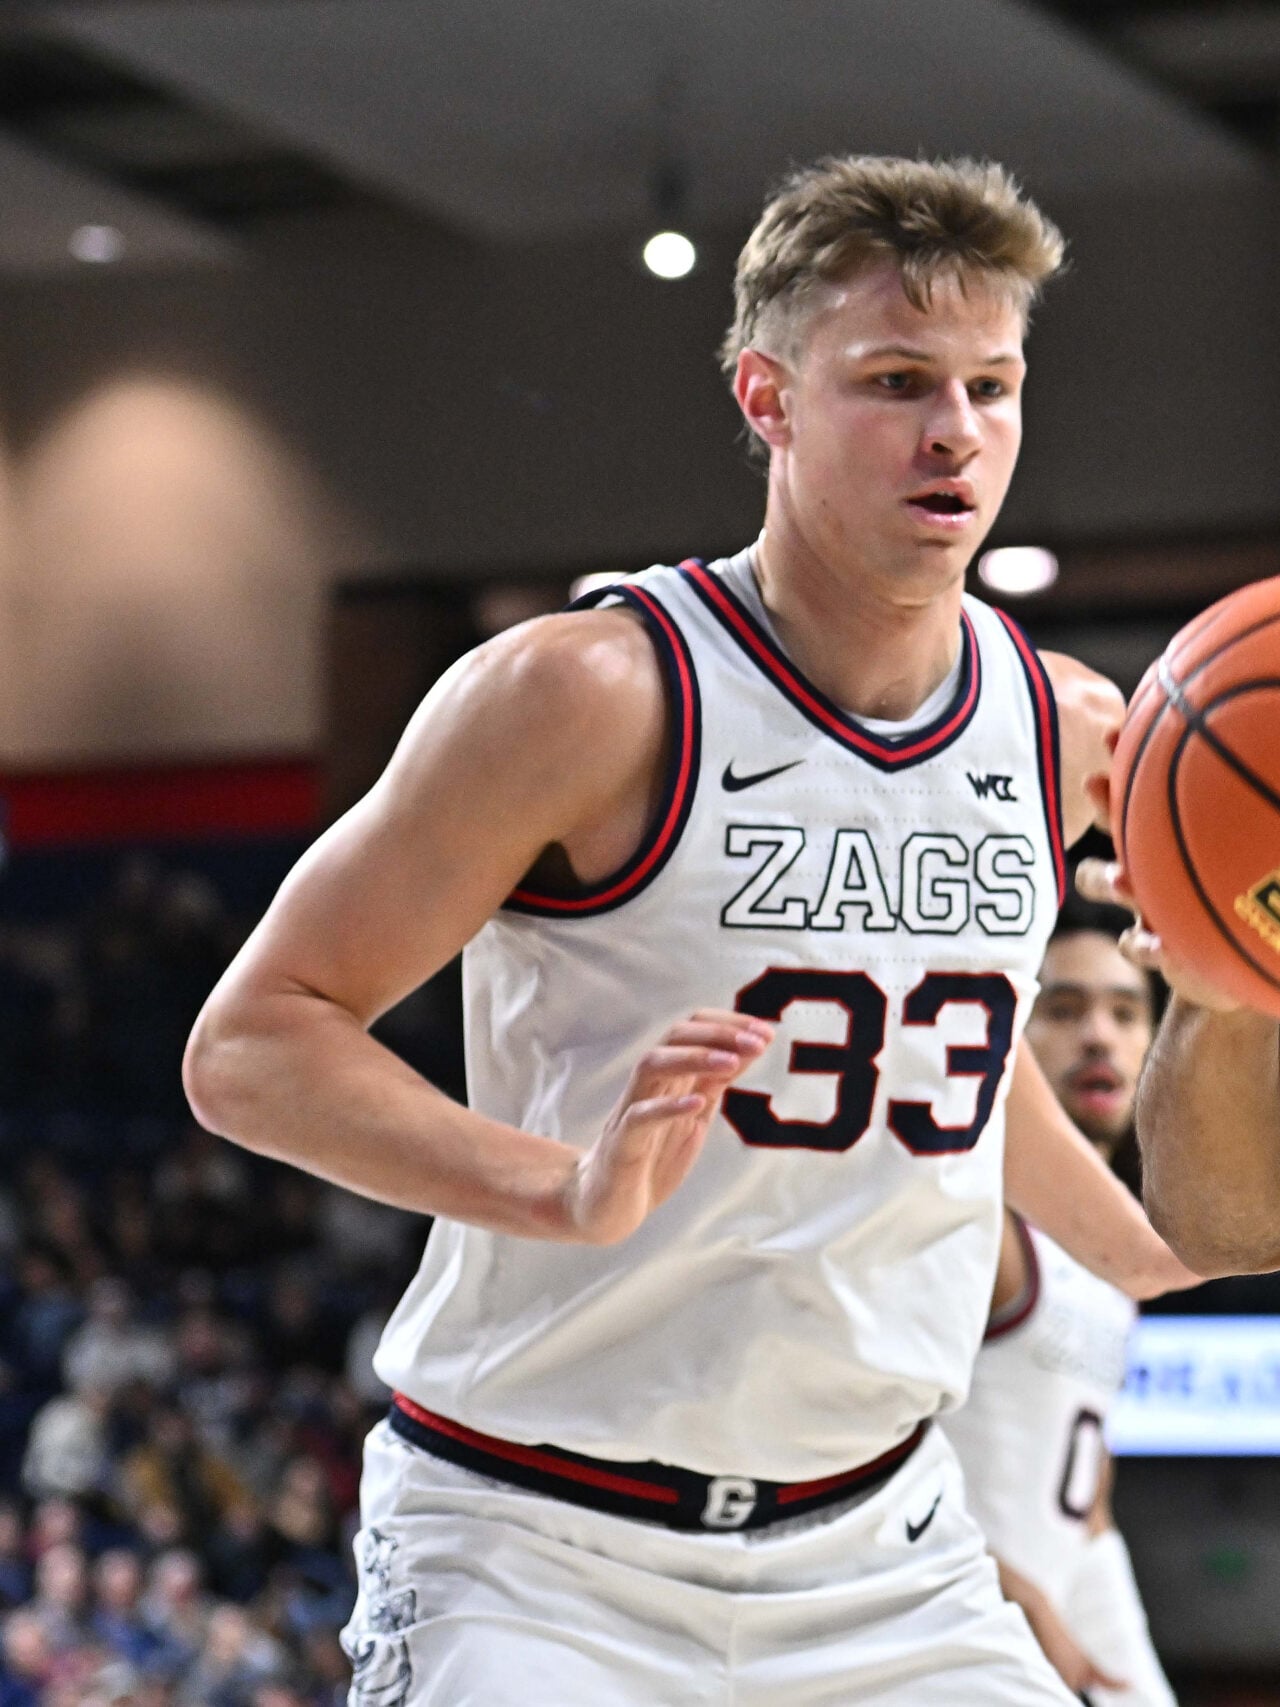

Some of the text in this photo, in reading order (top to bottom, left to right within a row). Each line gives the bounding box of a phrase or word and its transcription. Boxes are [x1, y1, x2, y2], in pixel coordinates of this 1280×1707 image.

[966, 772, 1018, 802] WCC
[720, 823, 1036, 936] ZAGS
[721, 966, 1018, 1157] 33
[700, 1476, 757, 1528] G
